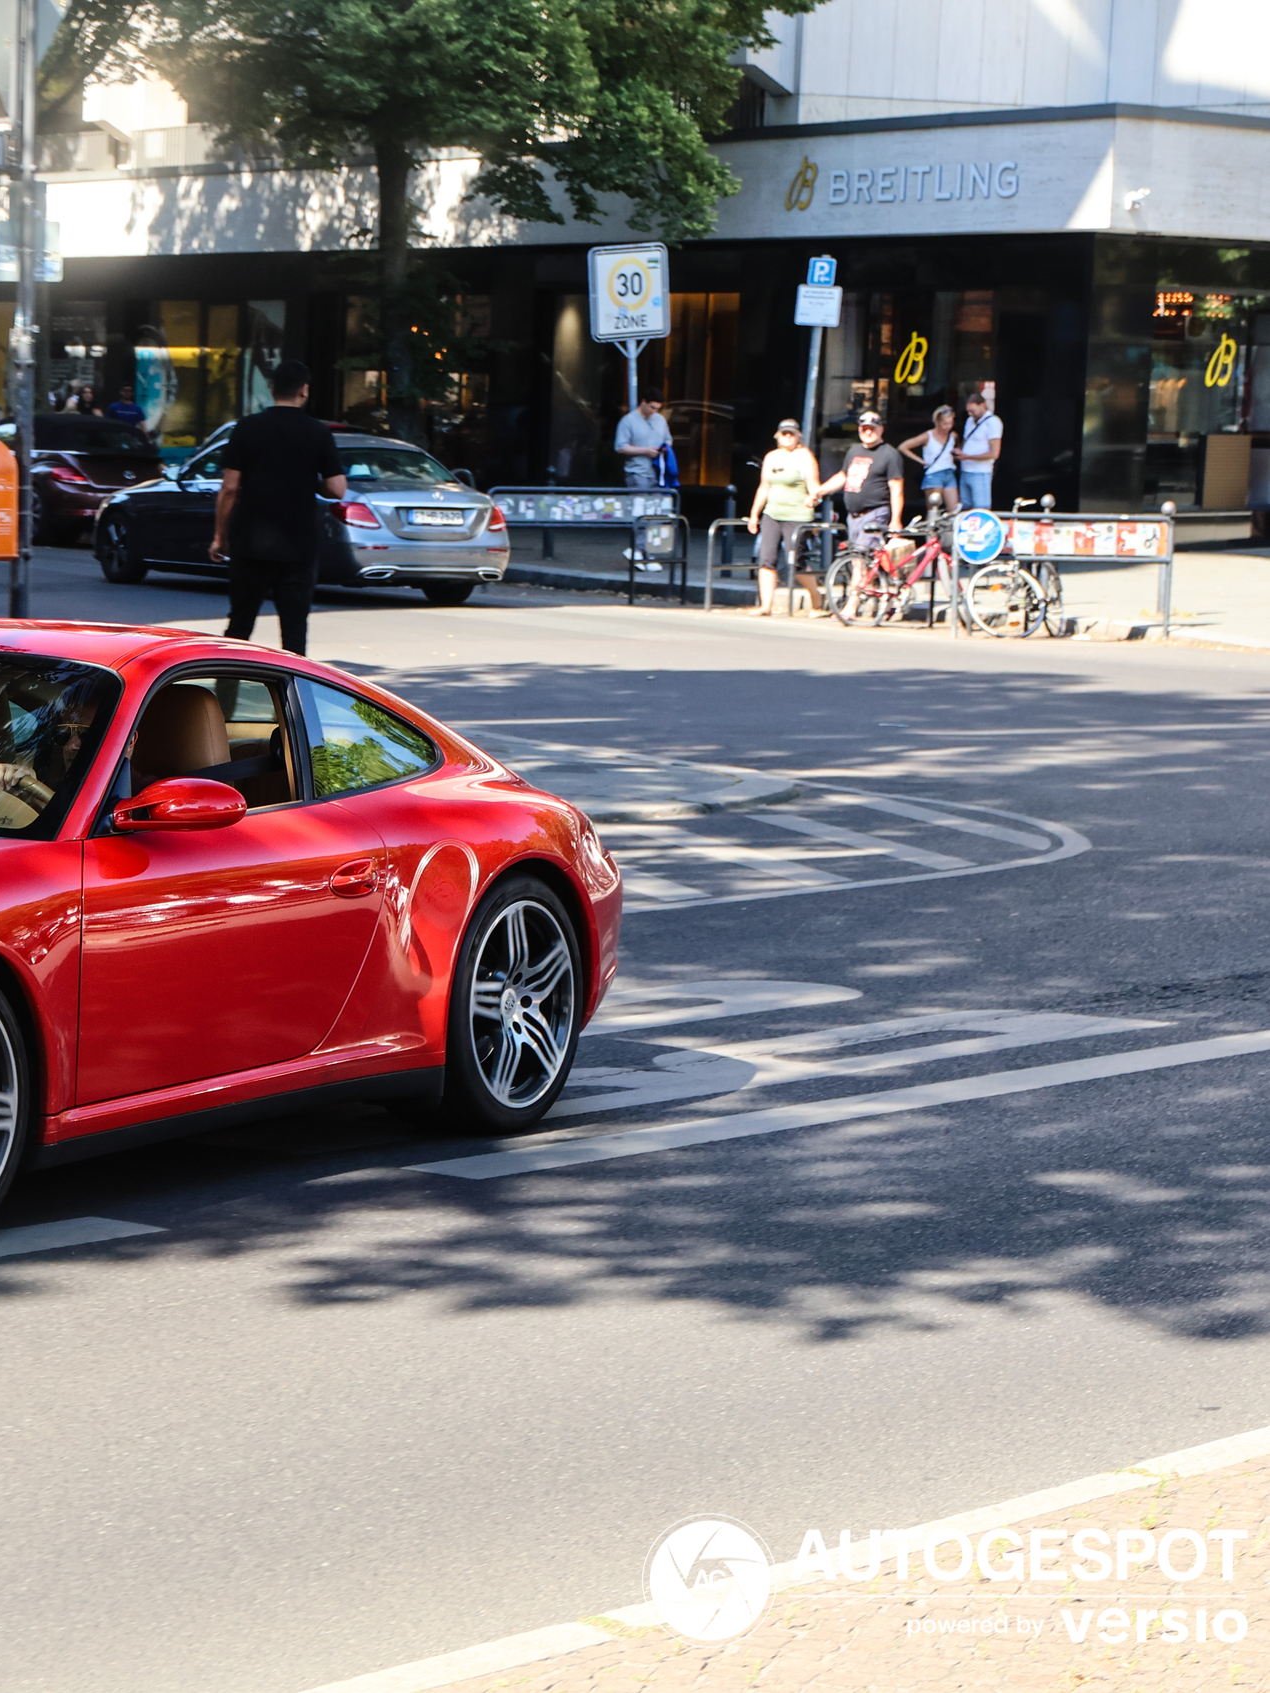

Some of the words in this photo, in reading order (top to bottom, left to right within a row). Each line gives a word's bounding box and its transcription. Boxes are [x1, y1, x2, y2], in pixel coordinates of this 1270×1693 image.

[830, 160, 1019, 205] BREITLING
[813, 261, 830, 283] P
[617, 272, 642, 296] 30
[614, 314, 647, 329] ZONE
